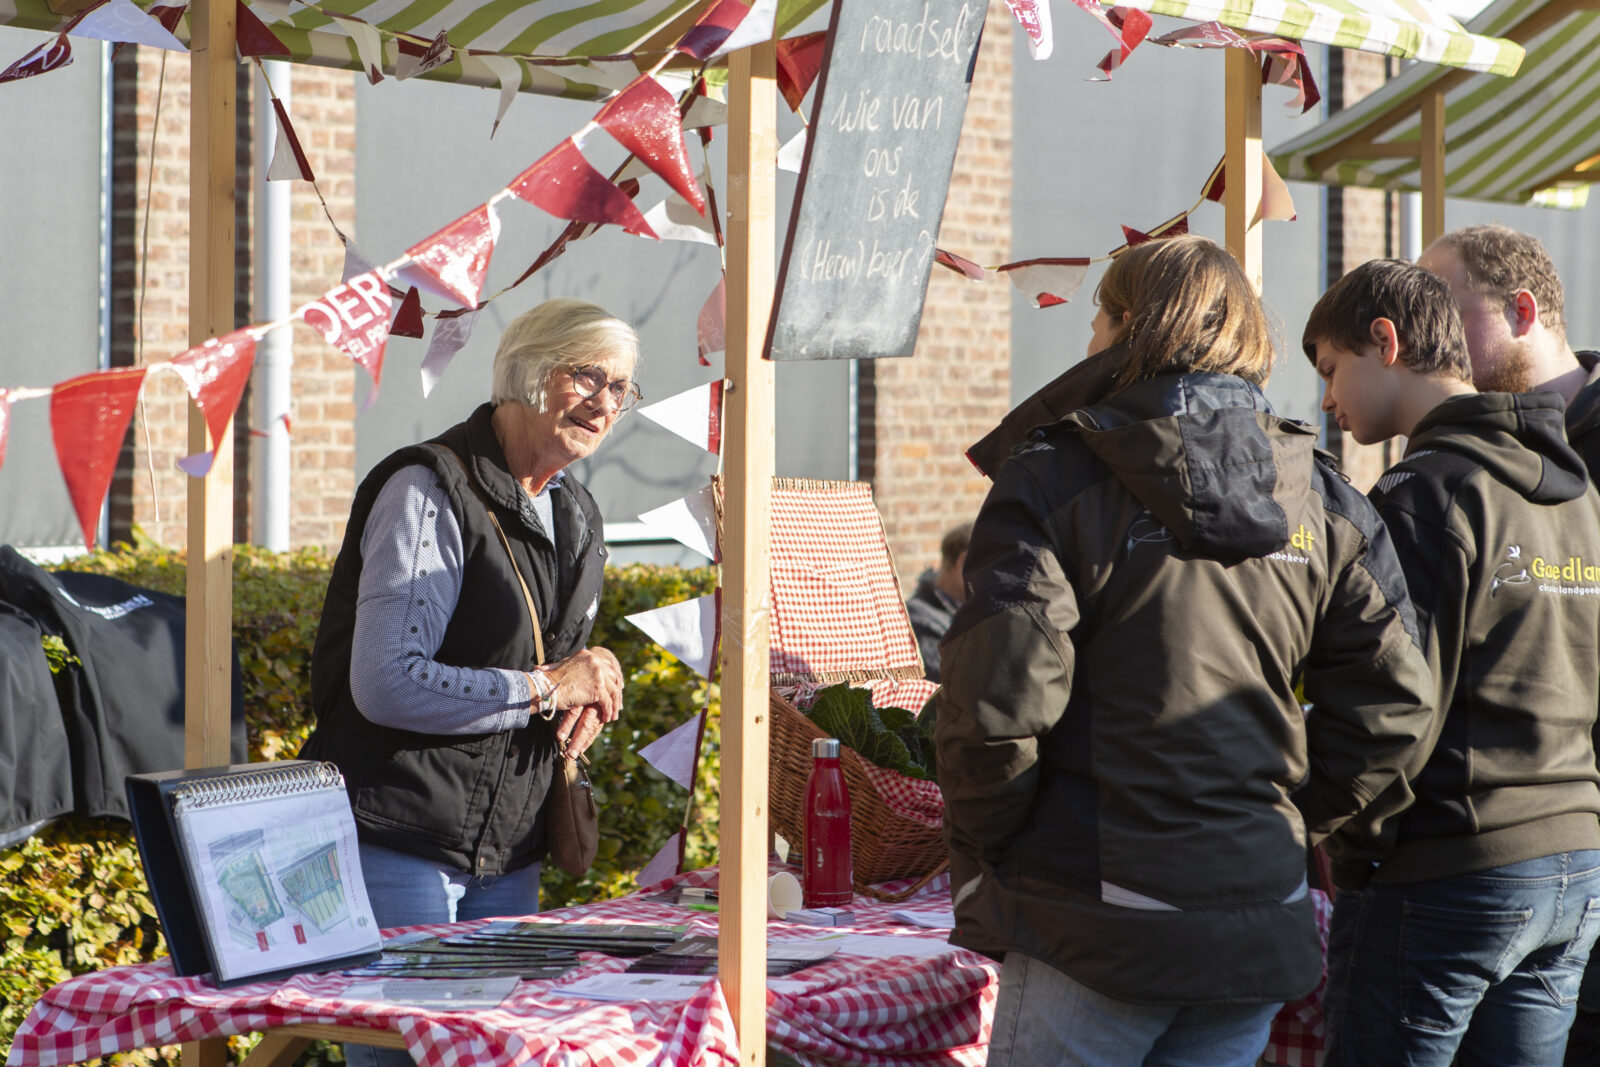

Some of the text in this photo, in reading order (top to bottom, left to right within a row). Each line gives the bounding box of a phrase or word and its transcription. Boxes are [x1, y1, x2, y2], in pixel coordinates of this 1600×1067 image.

[831, 88, 943, 133] Wie van
[864, 146, 903, 178] ons
[867, 172, 920, 223] is de
